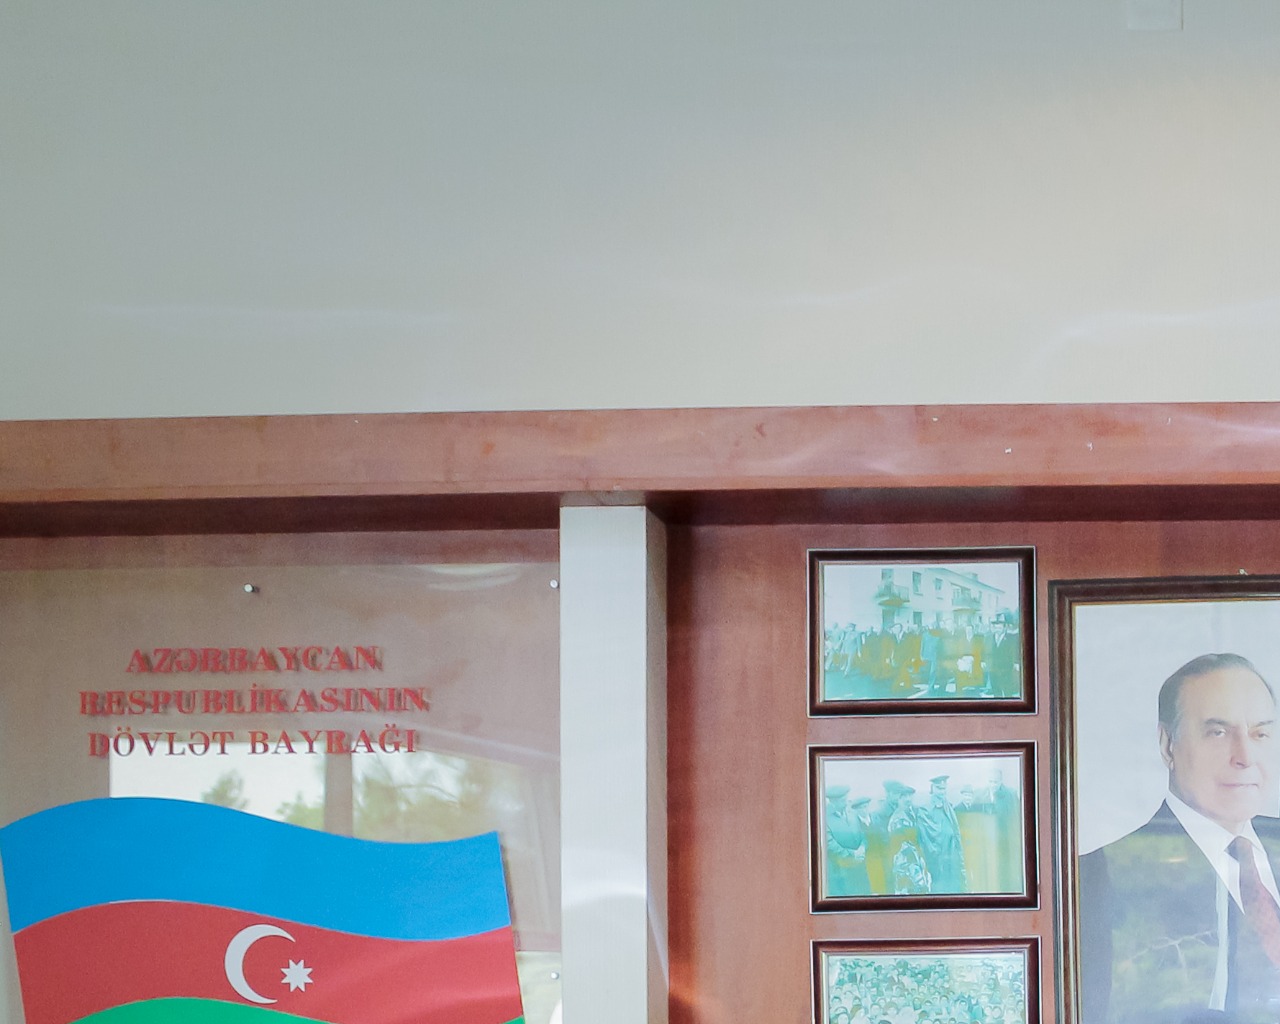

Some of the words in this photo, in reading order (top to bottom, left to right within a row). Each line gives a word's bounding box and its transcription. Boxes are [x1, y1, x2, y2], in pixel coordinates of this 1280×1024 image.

[126, 646, 383, 673] AZƏRBAYCAN
[79, 683, 430, 715] RESPUBLİKASININ
[88, 726, 235, 757] DÖVLƏT
[247, 724, 418, 756] BAYRAĞI
